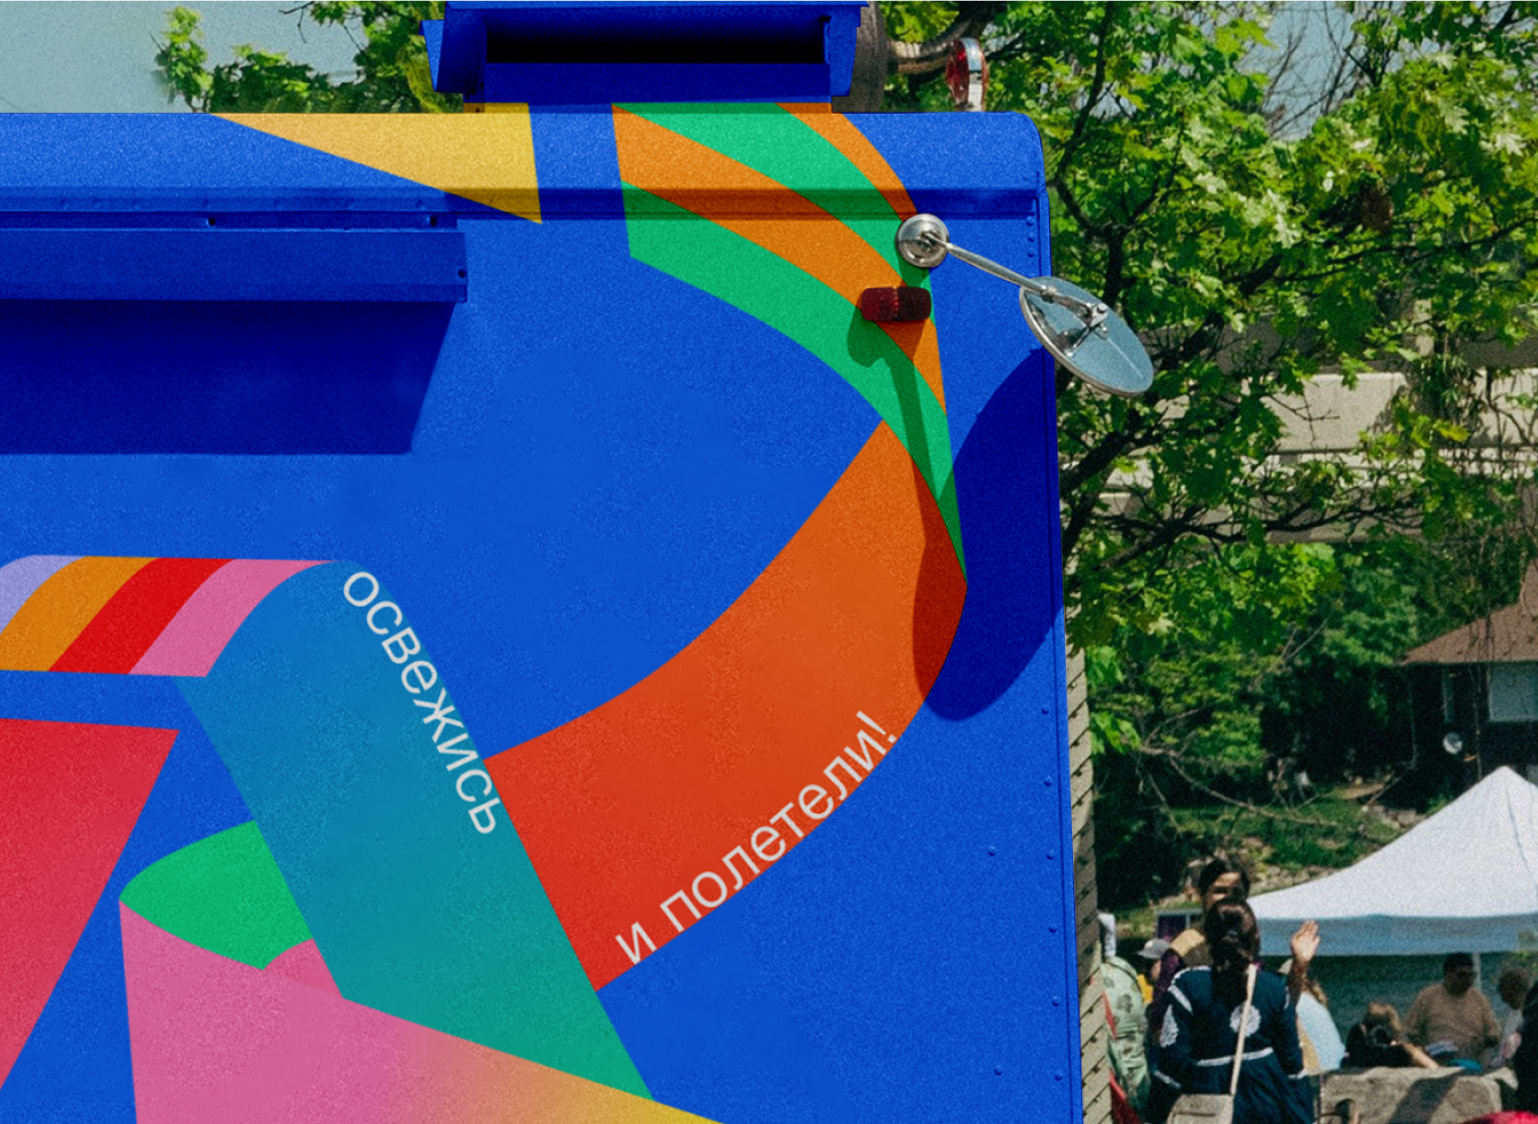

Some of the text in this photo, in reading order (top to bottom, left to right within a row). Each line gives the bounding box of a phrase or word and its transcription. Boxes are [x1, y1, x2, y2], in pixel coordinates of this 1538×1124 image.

[343, 571, 501, 835] освежись
[615, 710, 898, 965] и полетели!
